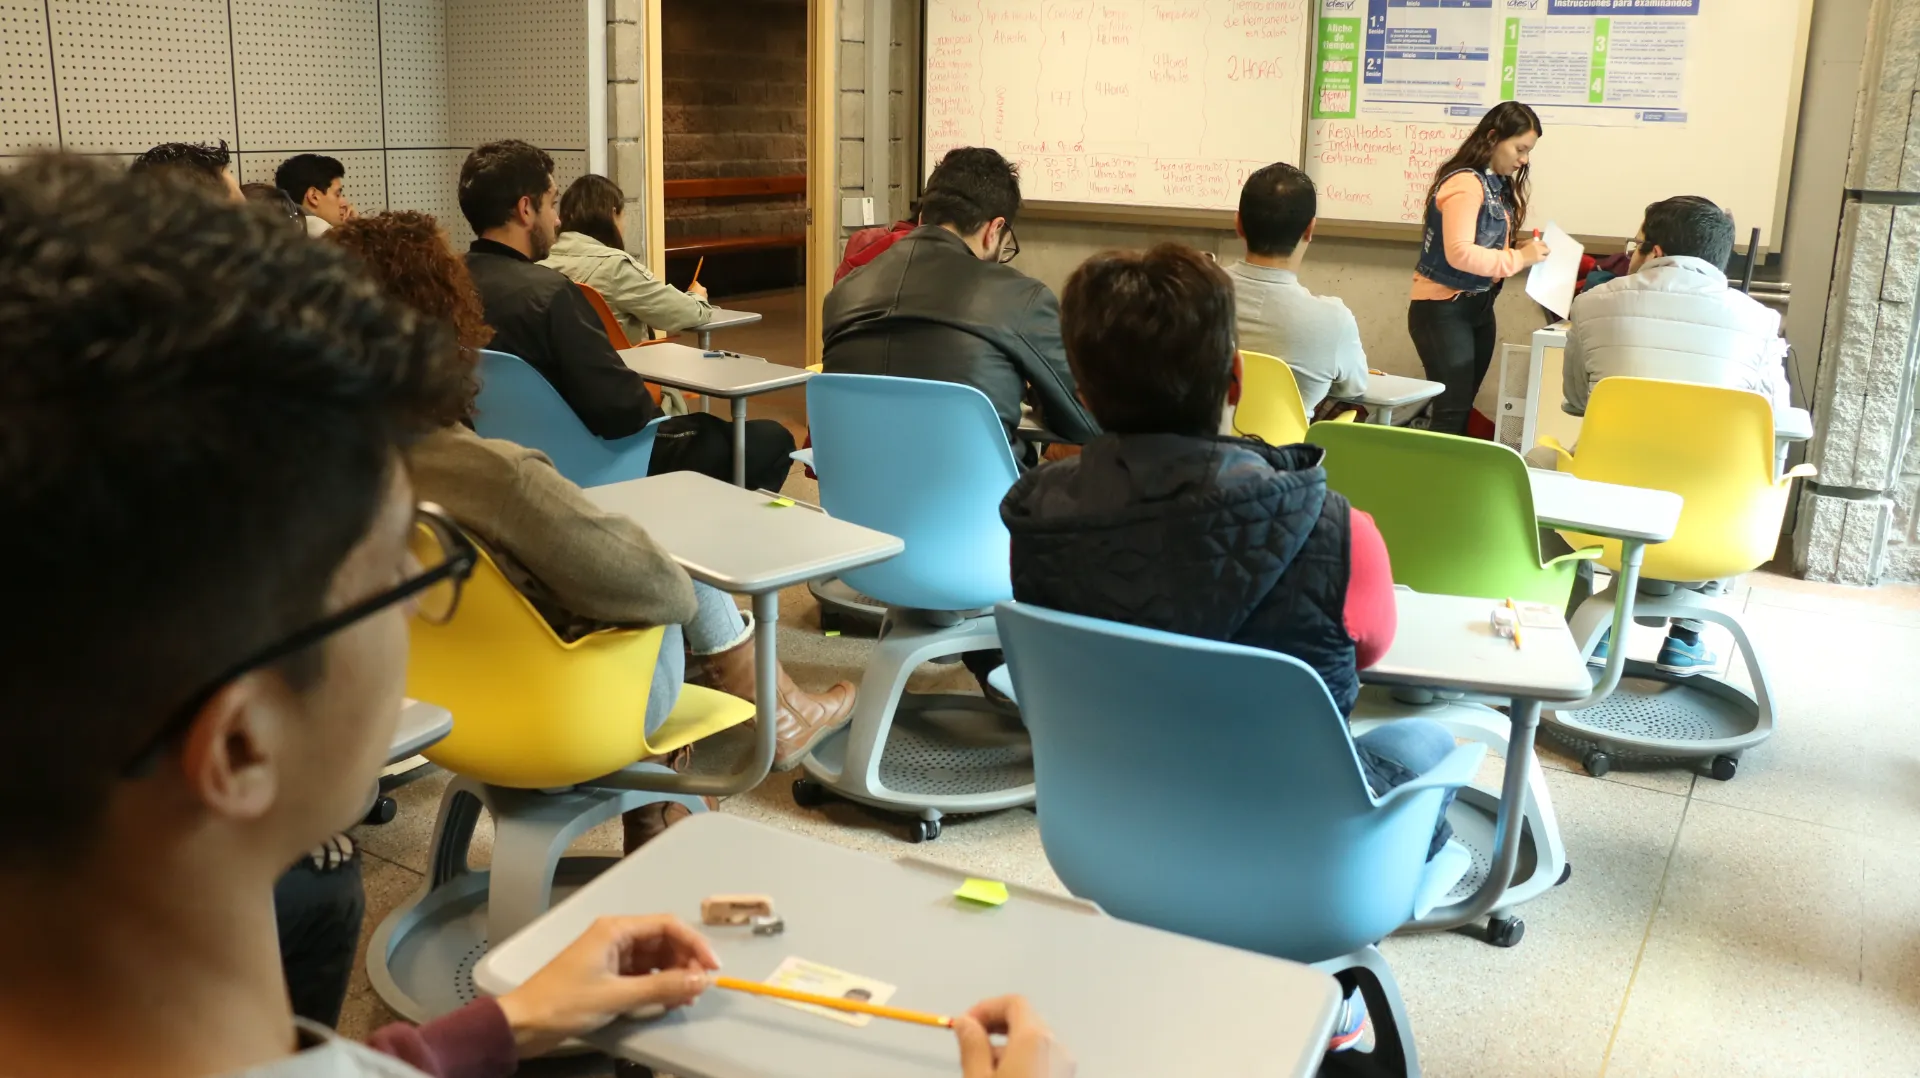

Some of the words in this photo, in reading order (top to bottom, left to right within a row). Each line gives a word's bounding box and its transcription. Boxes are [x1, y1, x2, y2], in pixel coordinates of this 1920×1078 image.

[1612, 0, 1633, 9] para
[1634, 0, 1693, 8] examinandos
[1334, 33, 1344, 42] de
[1508, 23, 1517, 40] 1
[1595, 36, 1606, 52] 3
[1227, 55, 1239, 81] 2
[1243, 57, 1283, 80] HORAS
[1503, 66, 1514, 82] 2
[1591, 78, 1603, 94] 4
[1328, 121, 1392, 139] Resultados
[1405, 124, 1417, 139] 18
[1410, 141, 1427, 155] 22
